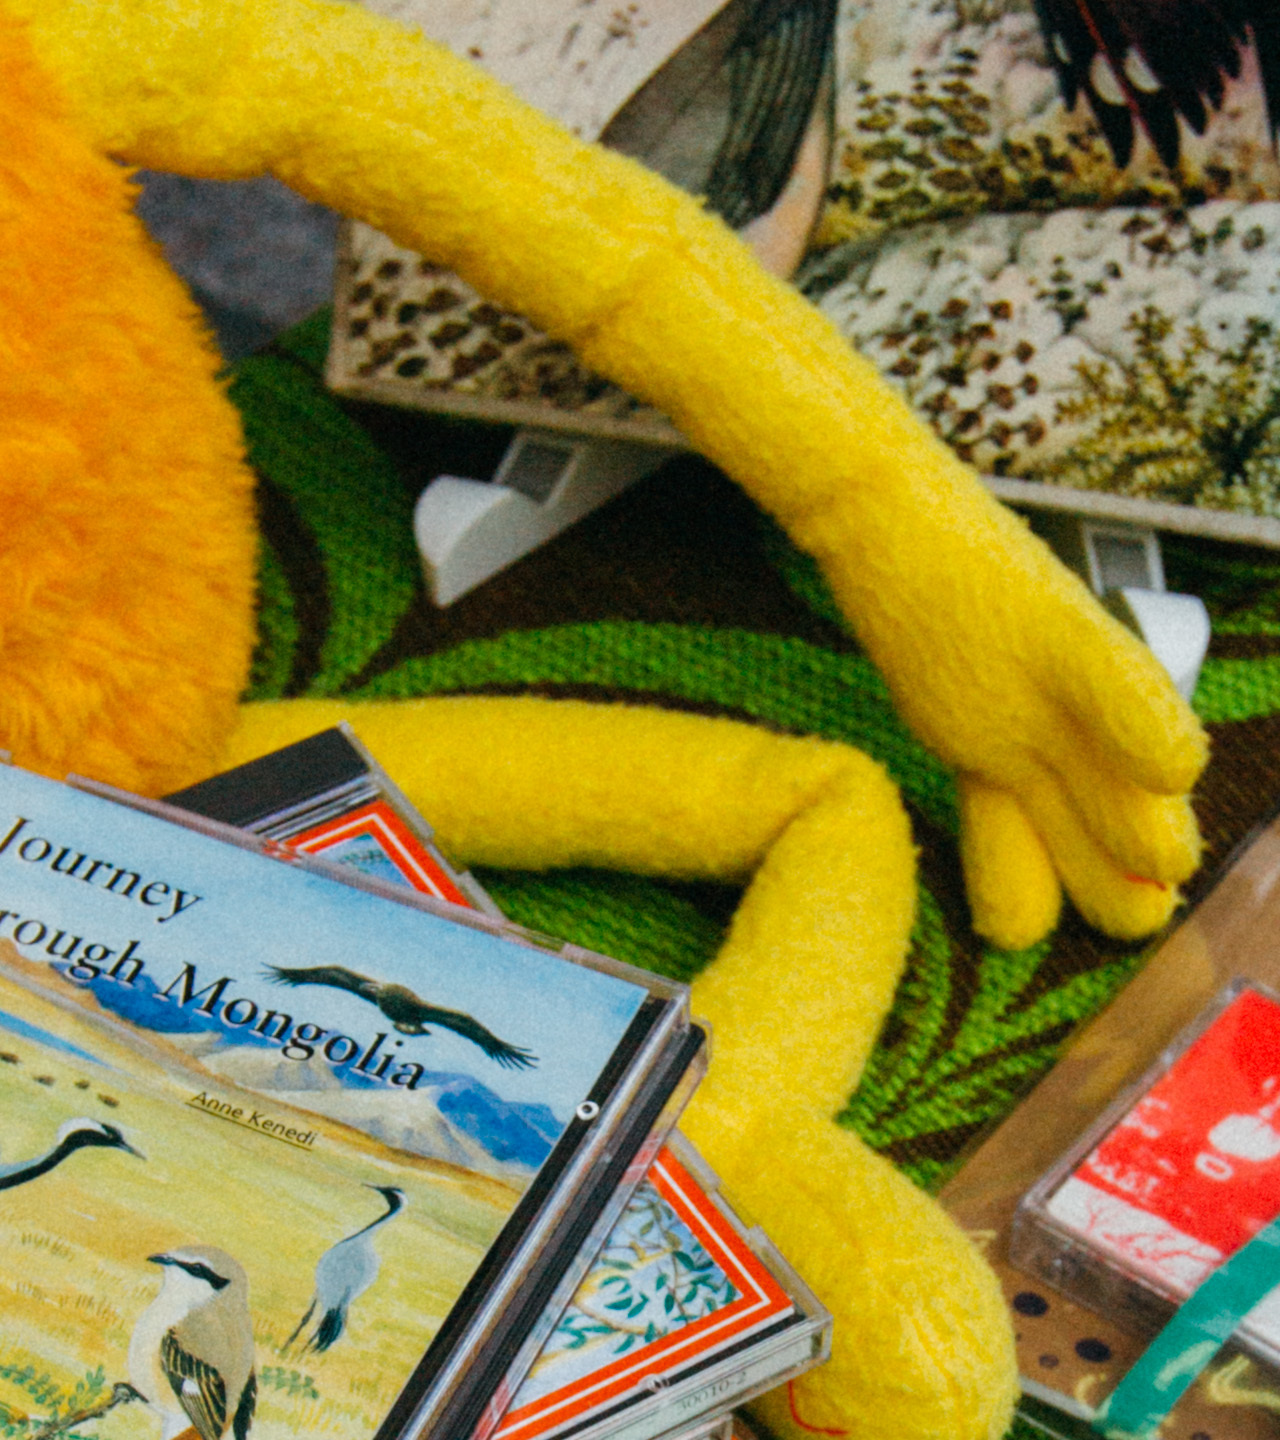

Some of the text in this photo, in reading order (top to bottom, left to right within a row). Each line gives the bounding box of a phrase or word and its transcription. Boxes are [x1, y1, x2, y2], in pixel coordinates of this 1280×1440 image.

[158, 962, 427, 1092] Mongolia
[192, 1091, 317, 1148] Anne Kenedi
